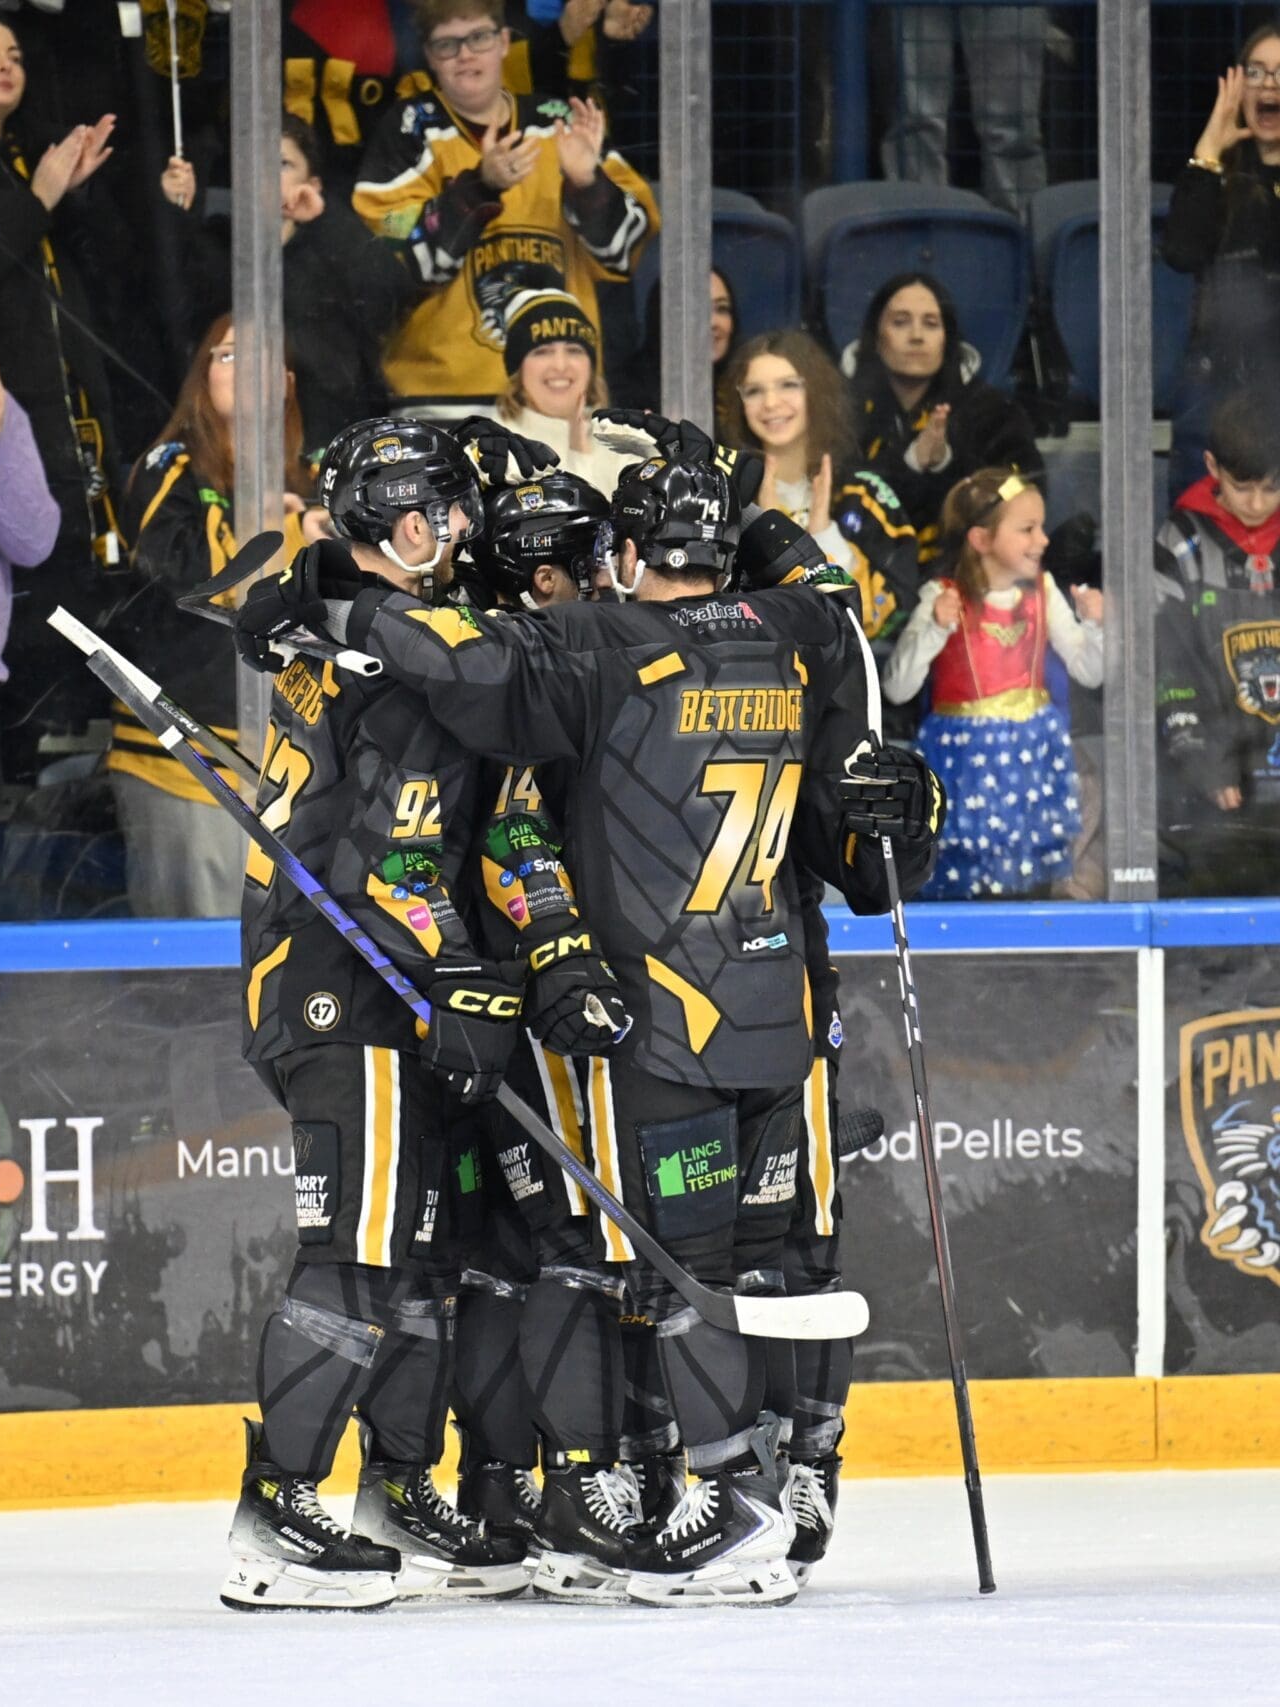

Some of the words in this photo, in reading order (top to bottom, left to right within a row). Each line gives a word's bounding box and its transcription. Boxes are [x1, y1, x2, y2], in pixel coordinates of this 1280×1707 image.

[623, 506, 644, 516] CCM
[698, 498, 720, 521] 74
[671, 552, 683, 565] 47
[493, 764, 544, 815] 14
[389, 778, 443, 840] 92
[509, 823, 534, 840] AIR
[680, 760, 804, 916] 74
[529, 933, 592, 972] CM
[311, 1002, 332, 1021] 47
[447, 988, 524, 1018] CC
[681, 1140, 722, 1163] LINCS
[934, 1118, 1085, 1160] Pellets
[177, 1140, 295, 1179] Manu
[685, 1160, 710, 1179] AIR
[295, 1175, 328, 1191] ARRY
[686, 1164, 738, 1193] TESTING
[295, 1192, 329, 1208] AMILY
[682, 1532, 723, 1559] BAUER
